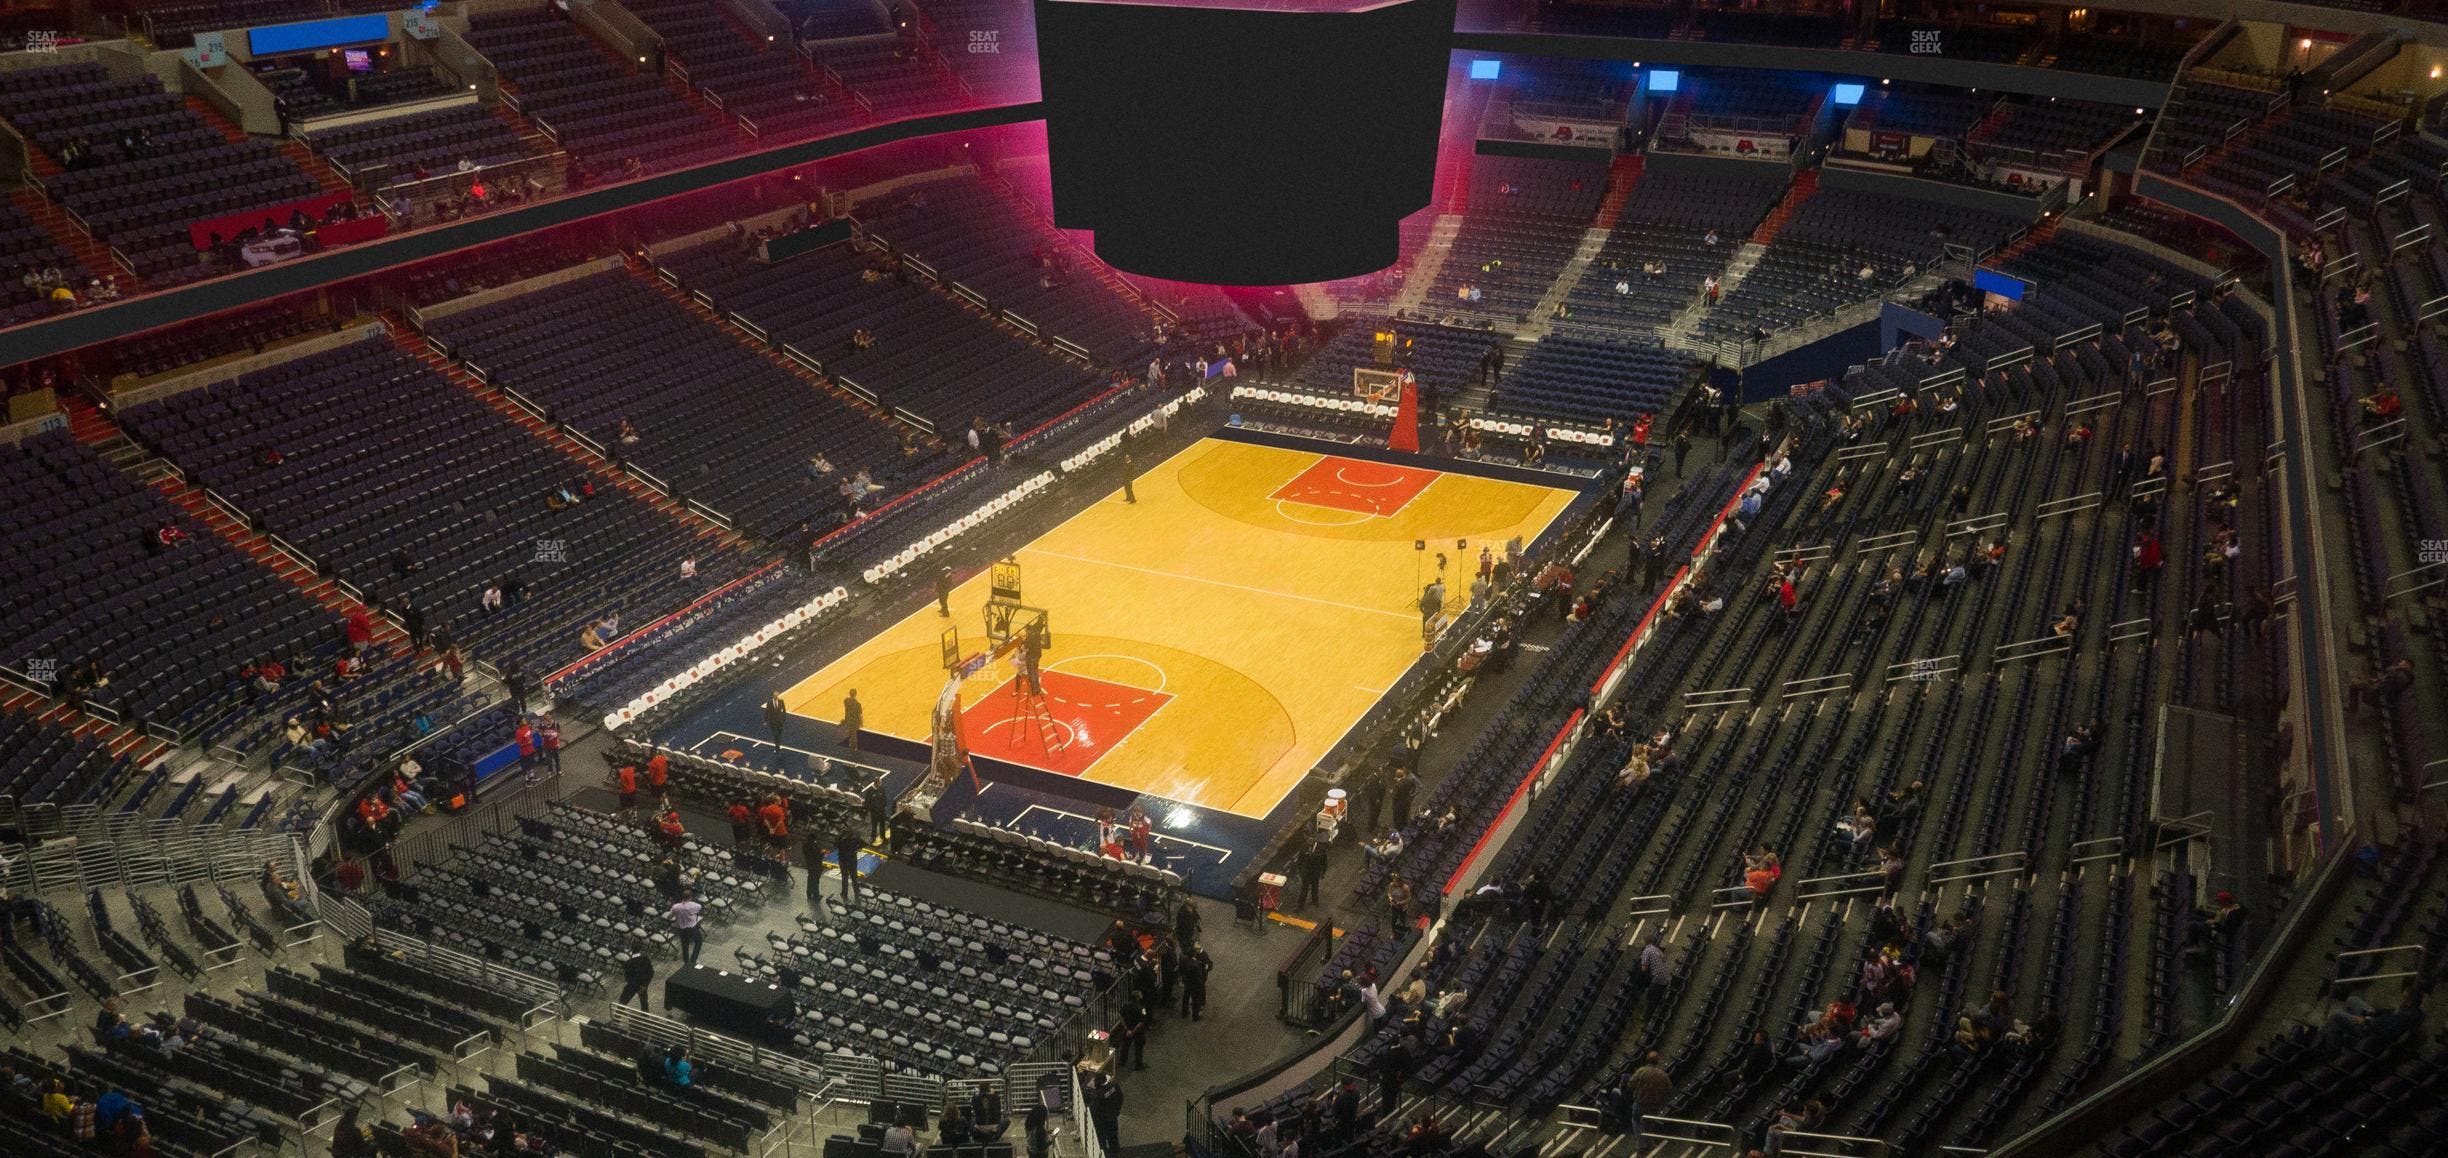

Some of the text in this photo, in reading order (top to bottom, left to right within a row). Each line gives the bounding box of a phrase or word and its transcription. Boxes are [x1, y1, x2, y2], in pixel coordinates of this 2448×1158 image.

[406, 17, 419, 28] 215
[208, 42, 224, 52] 215
[367, 326, 381, 337] 112
